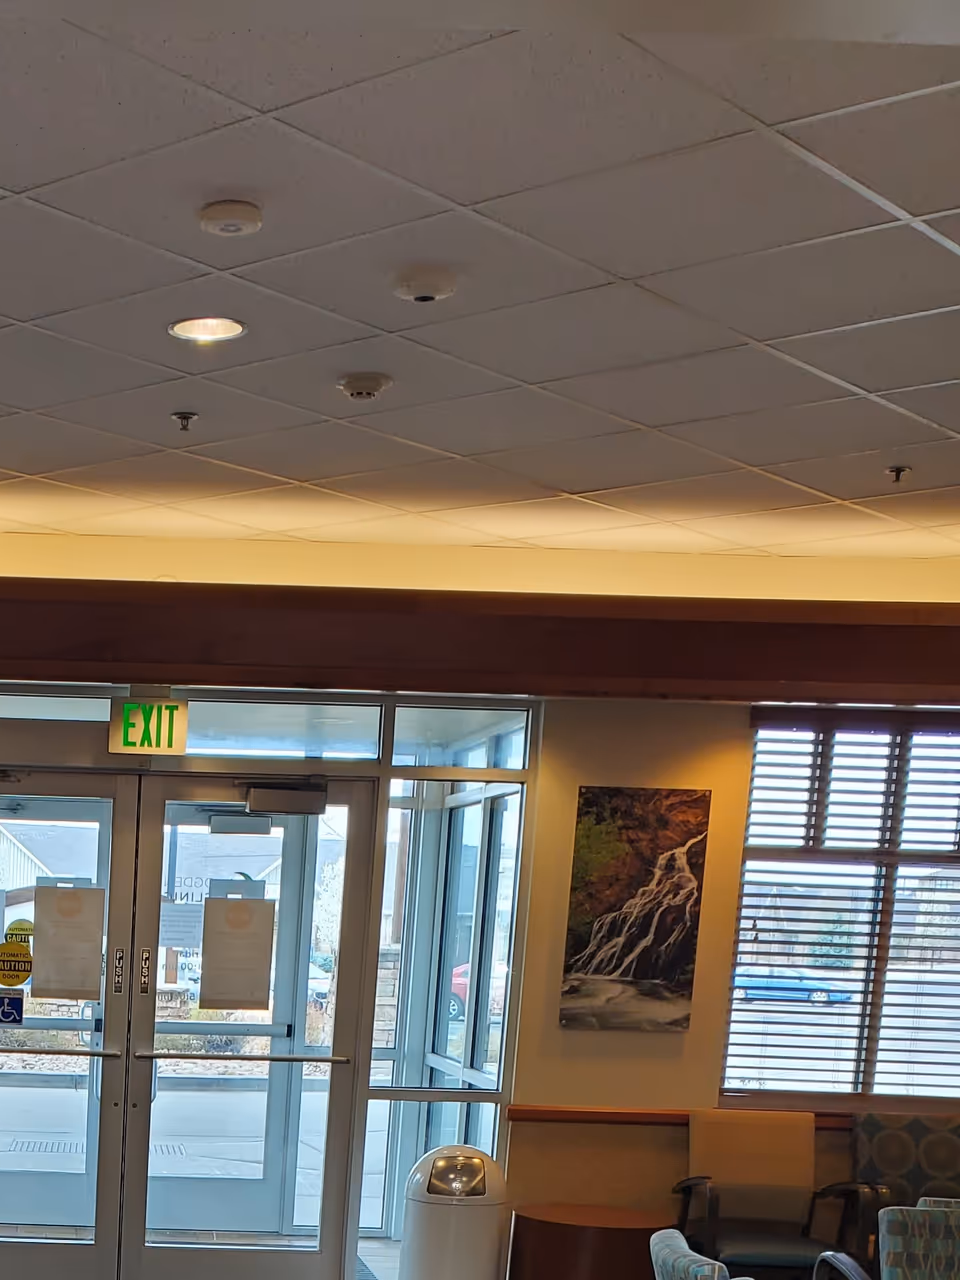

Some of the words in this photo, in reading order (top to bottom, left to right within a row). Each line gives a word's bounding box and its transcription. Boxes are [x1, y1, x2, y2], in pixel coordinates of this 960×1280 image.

[122, 703, 179, 748] EXIT
[7, 934, 28, 942] CAUTI
[115, 951, 123, 983] PUSH
[141, 952, 149, 984] PUSH
